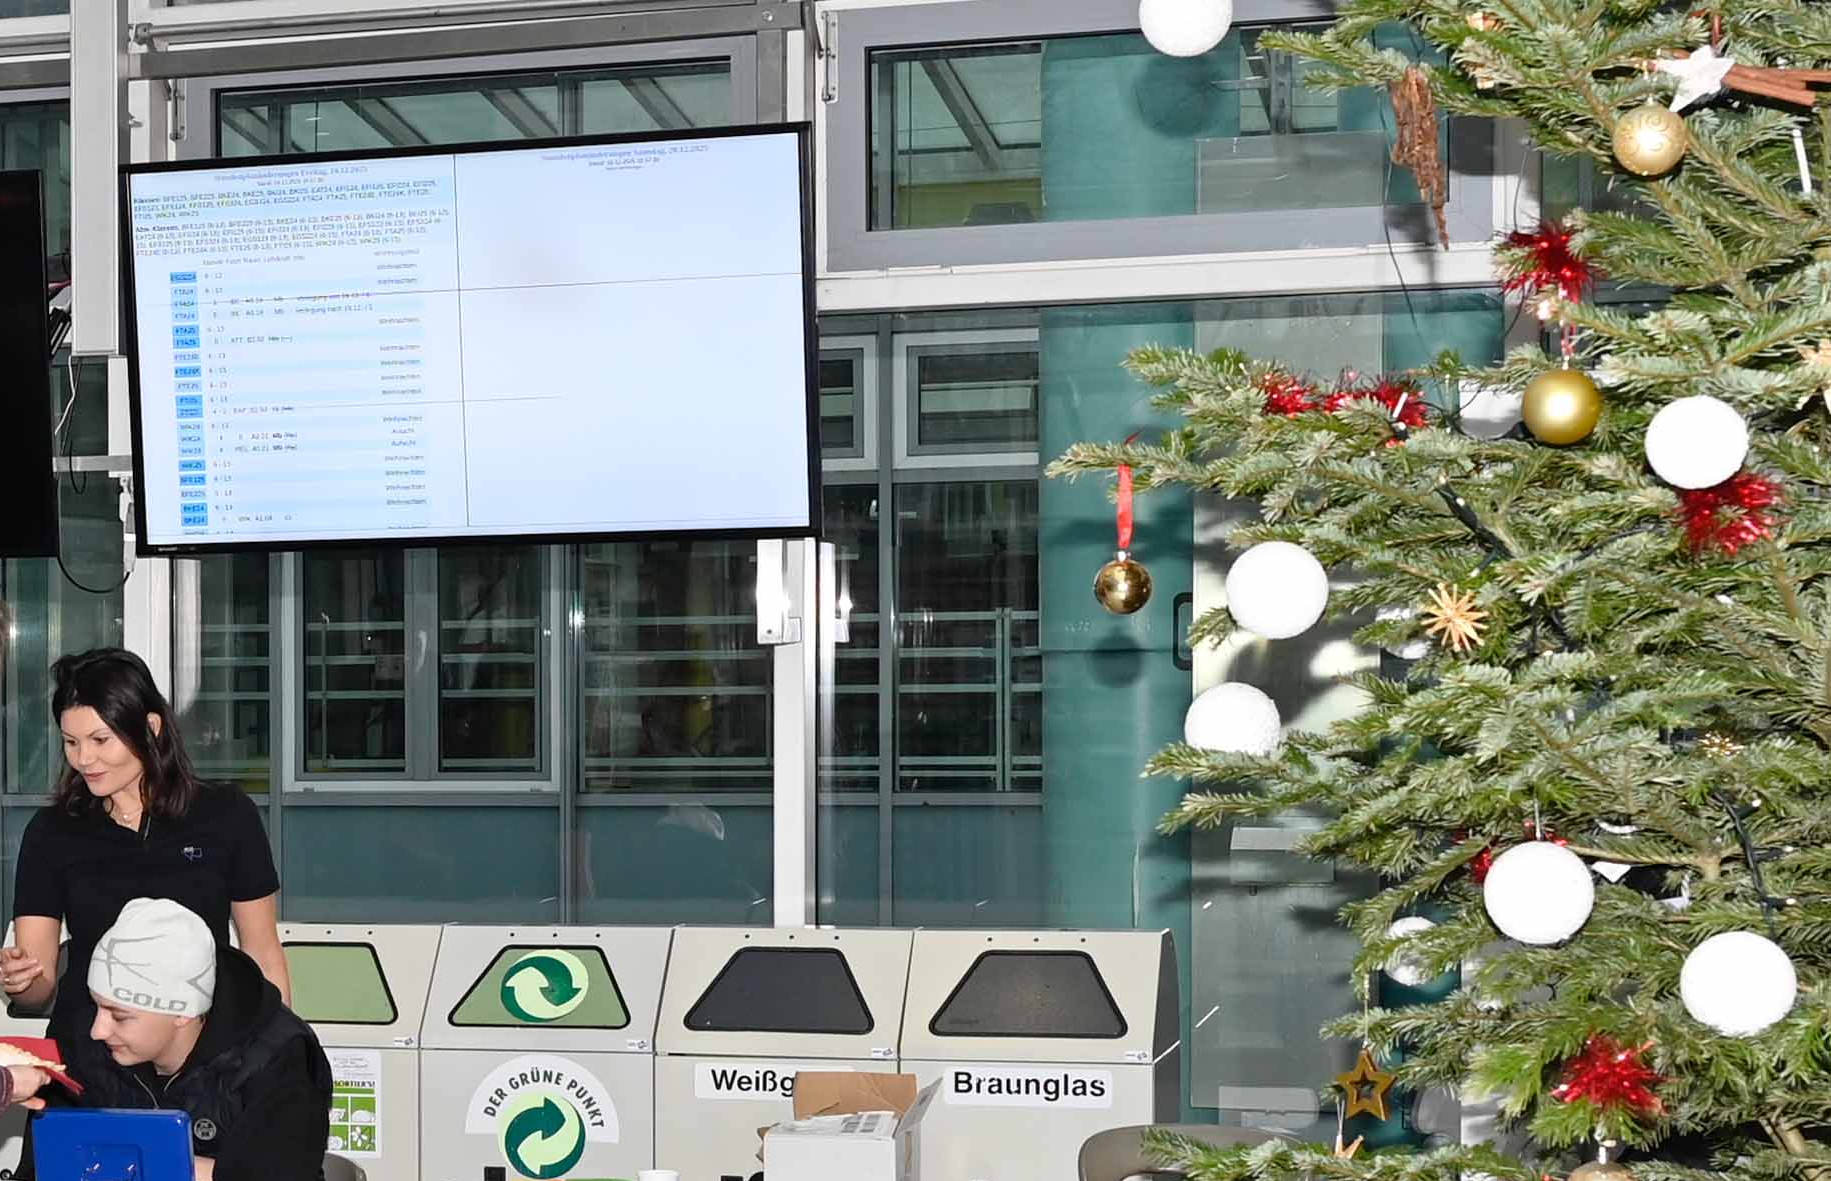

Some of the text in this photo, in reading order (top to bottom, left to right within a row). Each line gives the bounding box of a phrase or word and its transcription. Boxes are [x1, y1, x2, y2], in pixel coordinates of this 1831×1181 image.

[113, 987, 187, 1012] COLD
[483, 1066, 605, 1128] DER GRÜNE PUNKT
[710, 1068, 796, 1098] Weißg
[953, 1071, 1106, 1101] Braunglas
